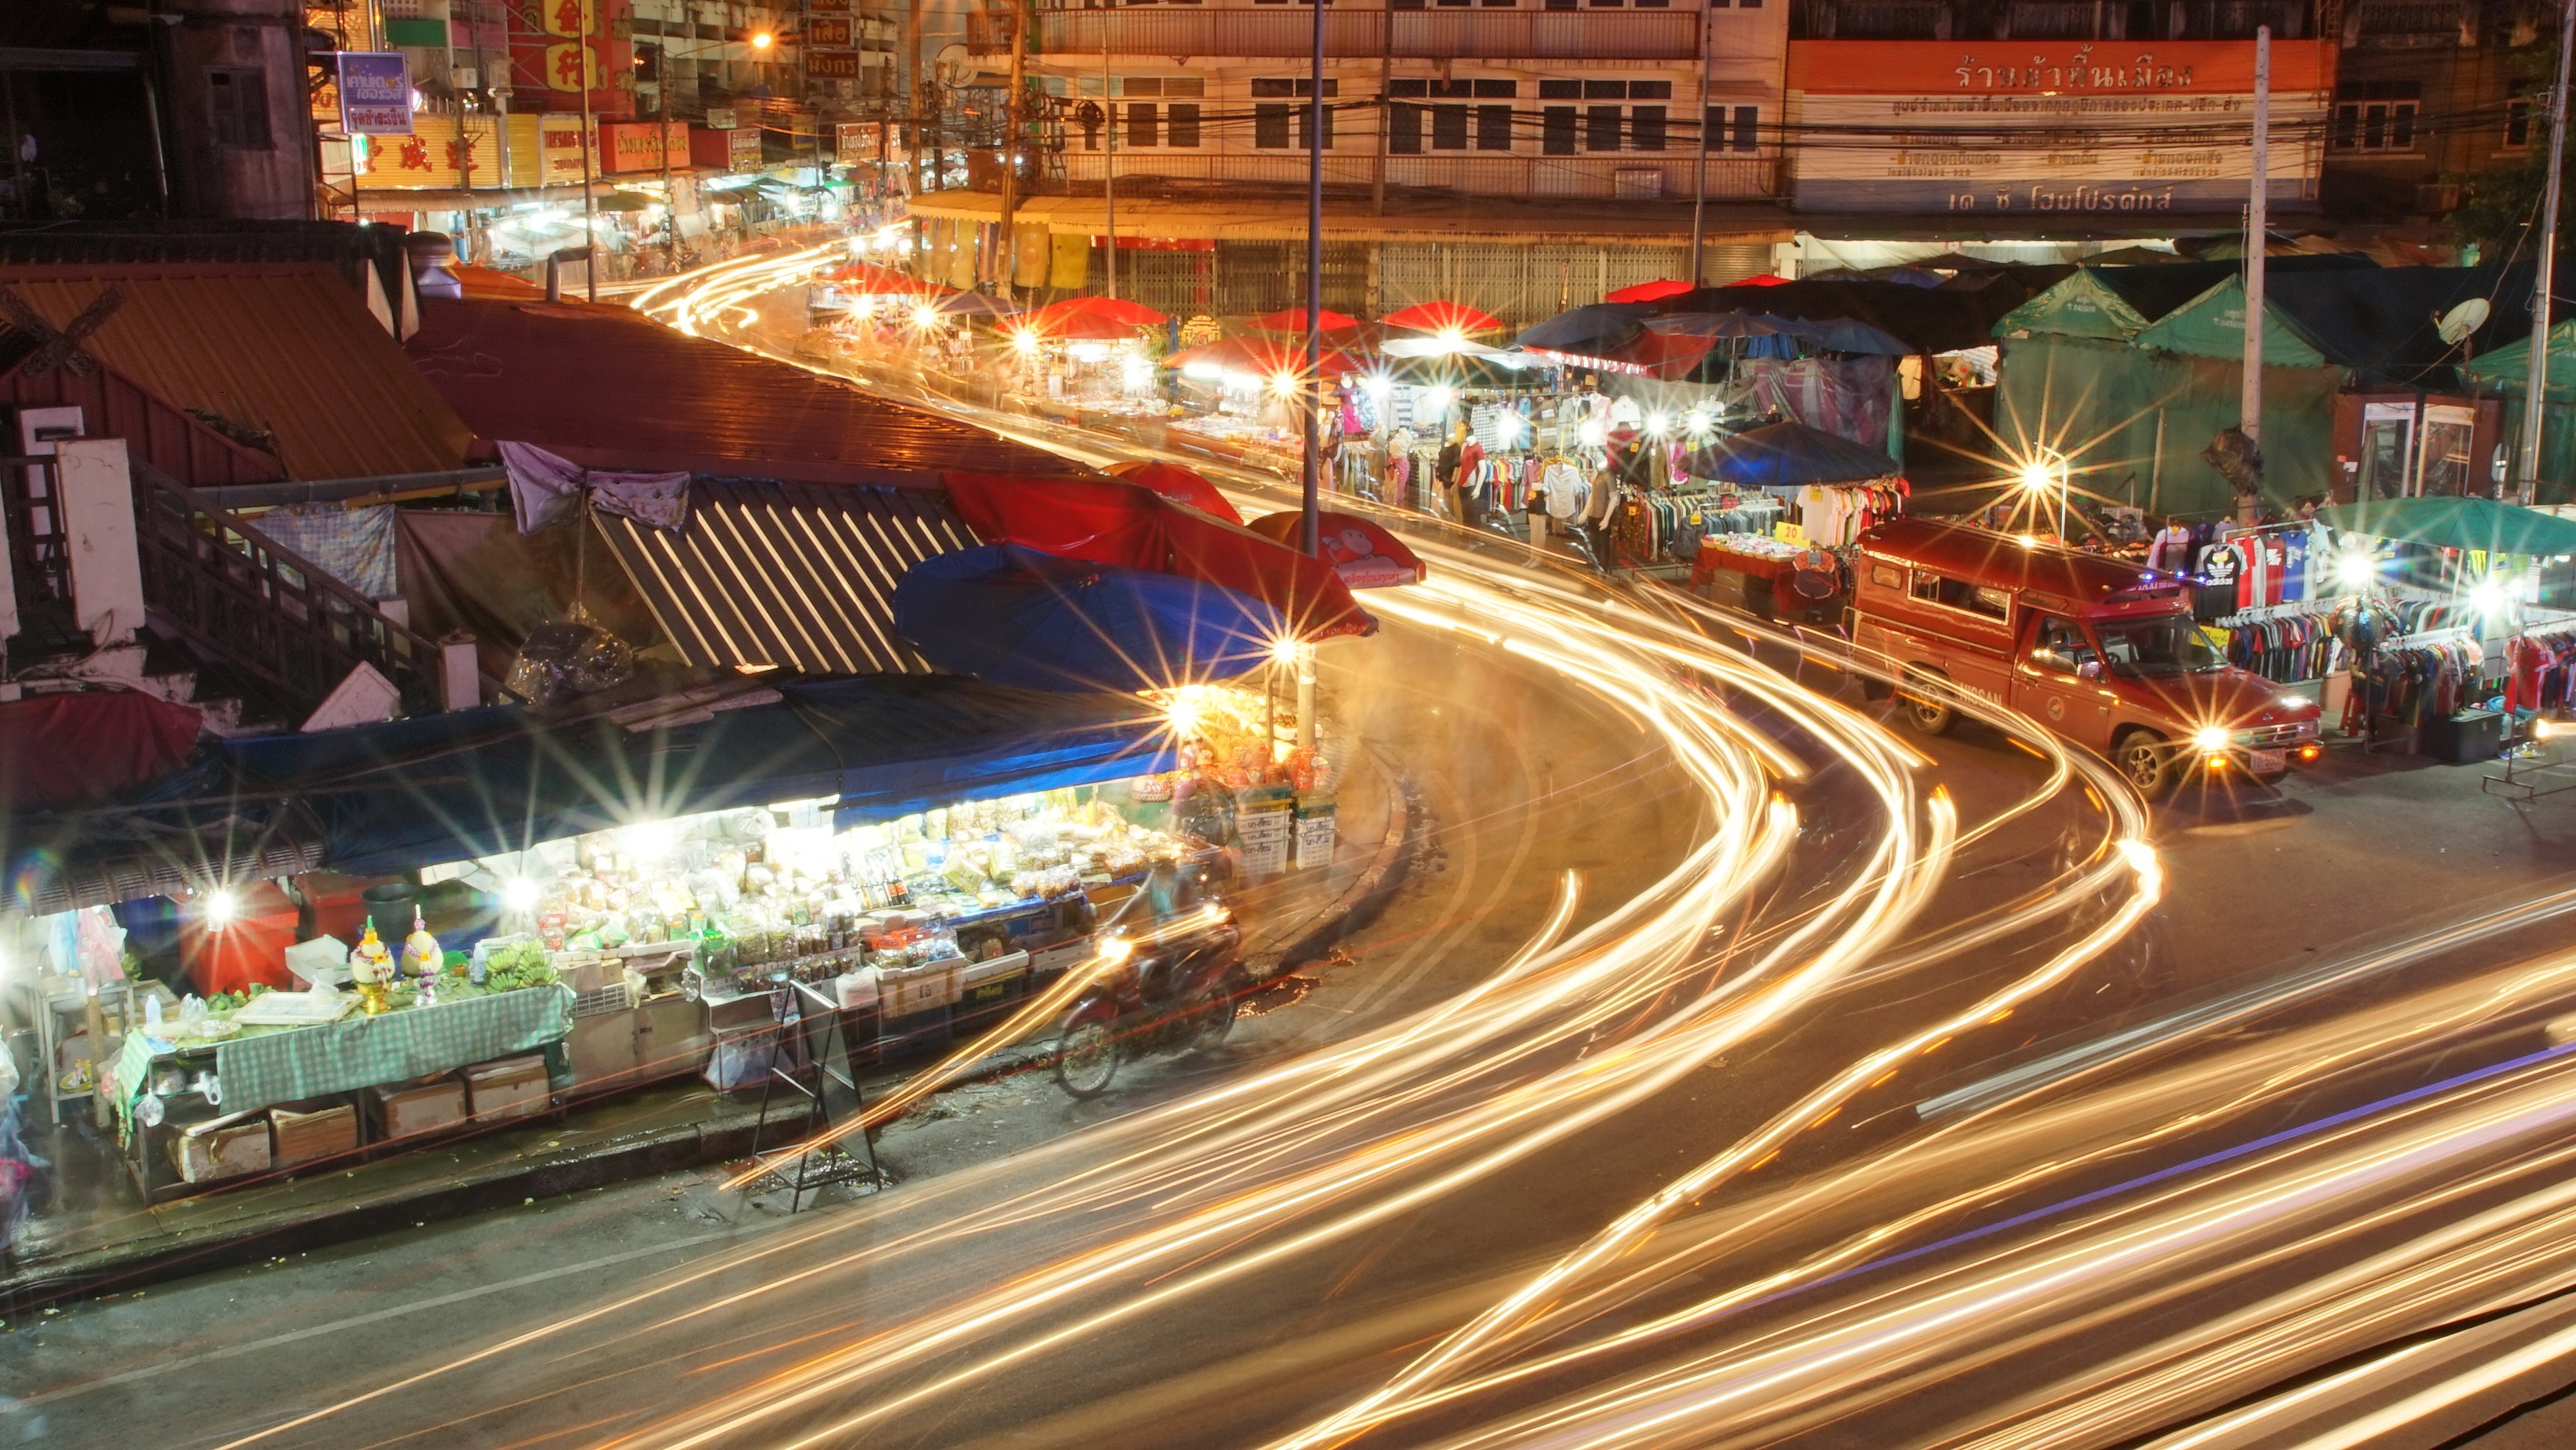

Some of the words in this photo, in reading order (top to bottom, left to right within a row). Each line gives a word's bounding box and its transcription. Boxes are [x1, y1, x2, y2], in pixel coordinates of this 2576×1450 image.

[1955, 43, 2192, 88] ร้านผ้าพื้นเมือง
[1949, 194, 1975, 211] เค
[1997, 185, 2011, 209] ซี
[2031, 185, 2172, 211] โฮมโปรดักส์
[2206, 577, 2234, 586] adidas
[1959, 682, 2003, 711] NISSAN
